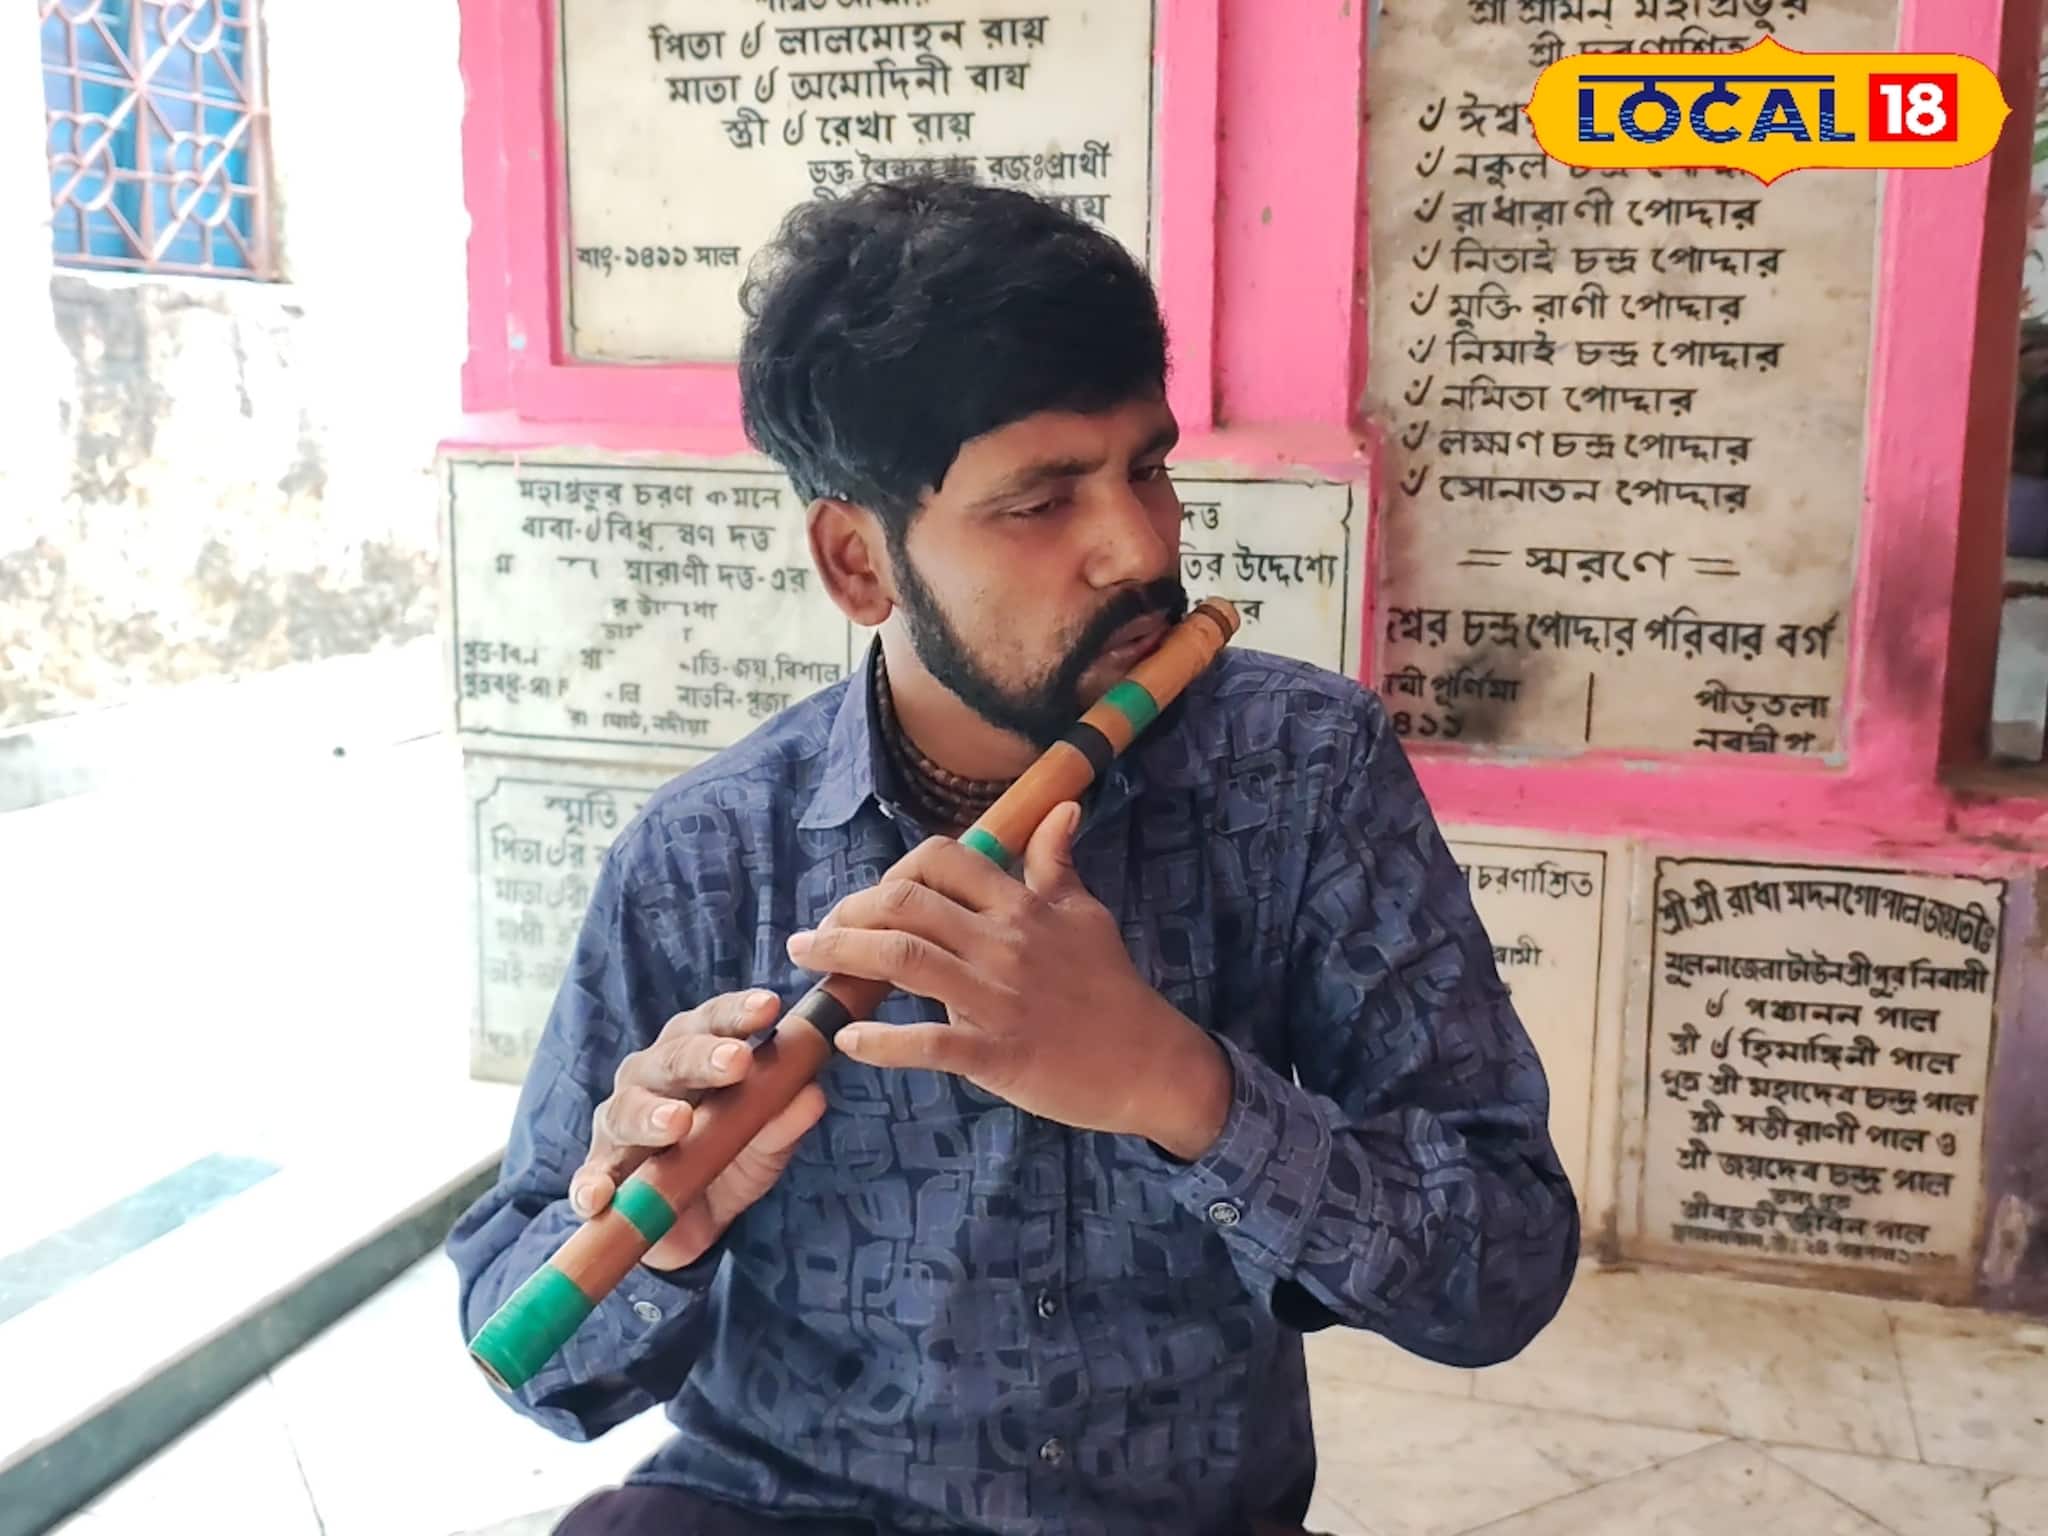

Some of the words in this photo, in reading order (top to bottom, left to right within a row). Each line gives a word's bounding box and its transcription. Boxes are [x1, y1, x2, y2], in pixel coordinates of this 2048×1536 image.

[649, 24, 726, 61] পিতা
[775, 20, 966, 54] লালমোহন
[979, 16, 1050, 50] রায়
[665, 75, 741, 104] মাতা
[788, 54, 952, 100] অমোদিনী
[721, 107, 769, 149] স্ত্রী
[816, 112, 896, 147] রেখা
[908, 111, 975, 144] রায়
[807, 158, 853, 185] ভক্ত
[1452, 152, 1548, 188] নকুল
[1627, 199, 1762, 231] পোদ্দার
[694, 246, 741, 267] সাল
[1451, 236, 1557, 273] নিতাই
[1570, 248, 1638, 274] চন্দ্র
[1652, 245, 1787, 278] পোদ্দার
[1449, 281, 1522, 329] মুক্তি
[1532, 281, 1609, 324] রাণী
[1621, 294, 1747, 325] পোদ্দার
[1446, 329, 1557, 366] নিমাই
[1575, 340, 1638, 368] চন্দ্র
[1653, 340, 1786, 372] পোদ্দার
[1441, 373, 1551, 411] নমিতা
[1561, 386, 1698, 417] পোদ্দার
[1552, 432, 1616, 459] চন্দ্র
[1625, 434, 1753, 465] পোদ্দার
[634, 484, 694, 507] চরণ
[1439, 476, 1601, 504] সোনাতন
[1616, 477, 1751, 513] পোদ্দার
[727, 524, 776, 551] দত্ত
[1526, 547, 1674, 583] স্মরণে
[1462, 610, 1518, 649] চন্দ্র
[1526, 611, 1637, 657] পোদ্দার
[1645, 605, 1765, 661] পরিবার
[1777, 610, 1840, 659] বর্গ
[1478, 860, 1594, 898] চরণাশ্রিত
[1724, 880, 1782, 918] রাধা
[1874, 1005, 1940, 1033] পাল
[1889, 1049, 1960, 1075] পাল
[1923, 1091, 1979, 1117] পাল
[1865, 1124, 1929, 1153] পাল
[1892, 1168, 1954, 1197] পাল
